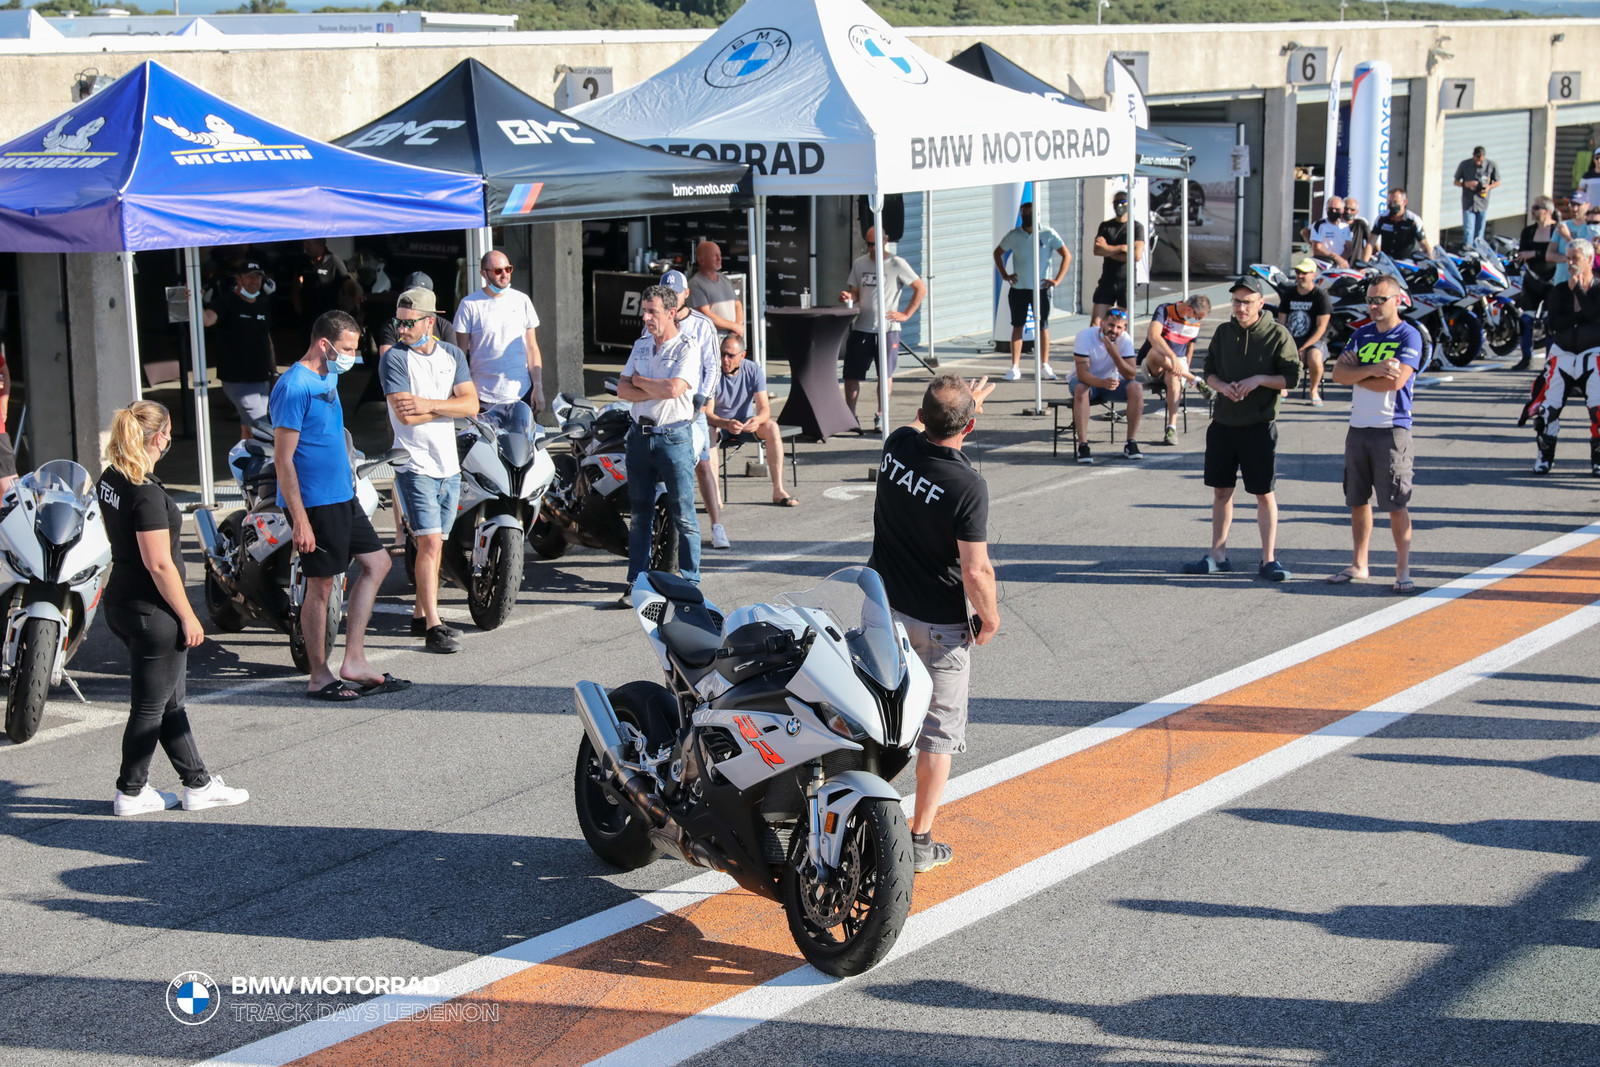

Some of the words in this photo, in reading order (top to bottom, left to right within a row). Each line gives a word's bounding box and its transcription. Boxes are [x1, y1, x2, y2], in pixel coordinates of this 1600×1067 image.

[339, 25, 357, 33] Racing
[732, 31, 787, 50] BMW
[1302, 53, 1316, 81] 6
[1454, 83, 1467, 108] 7
[1560, 76, 1572, 98] 8
[345, 119, 467, 149] BMC
[496, 119, 595, 145] BMC
[174, 150, 313, 165] MICHELIN
[910, 134, 973, 170] BMW
[982, 127, 1110, 165] MOTORRAD
[672, 183, 740, 197] bmc-moto.com
[1358, 342, 1400, 364] 46
[881, 453, 945, 504] STAFF
[100, 485, 120, 510] TEAM
